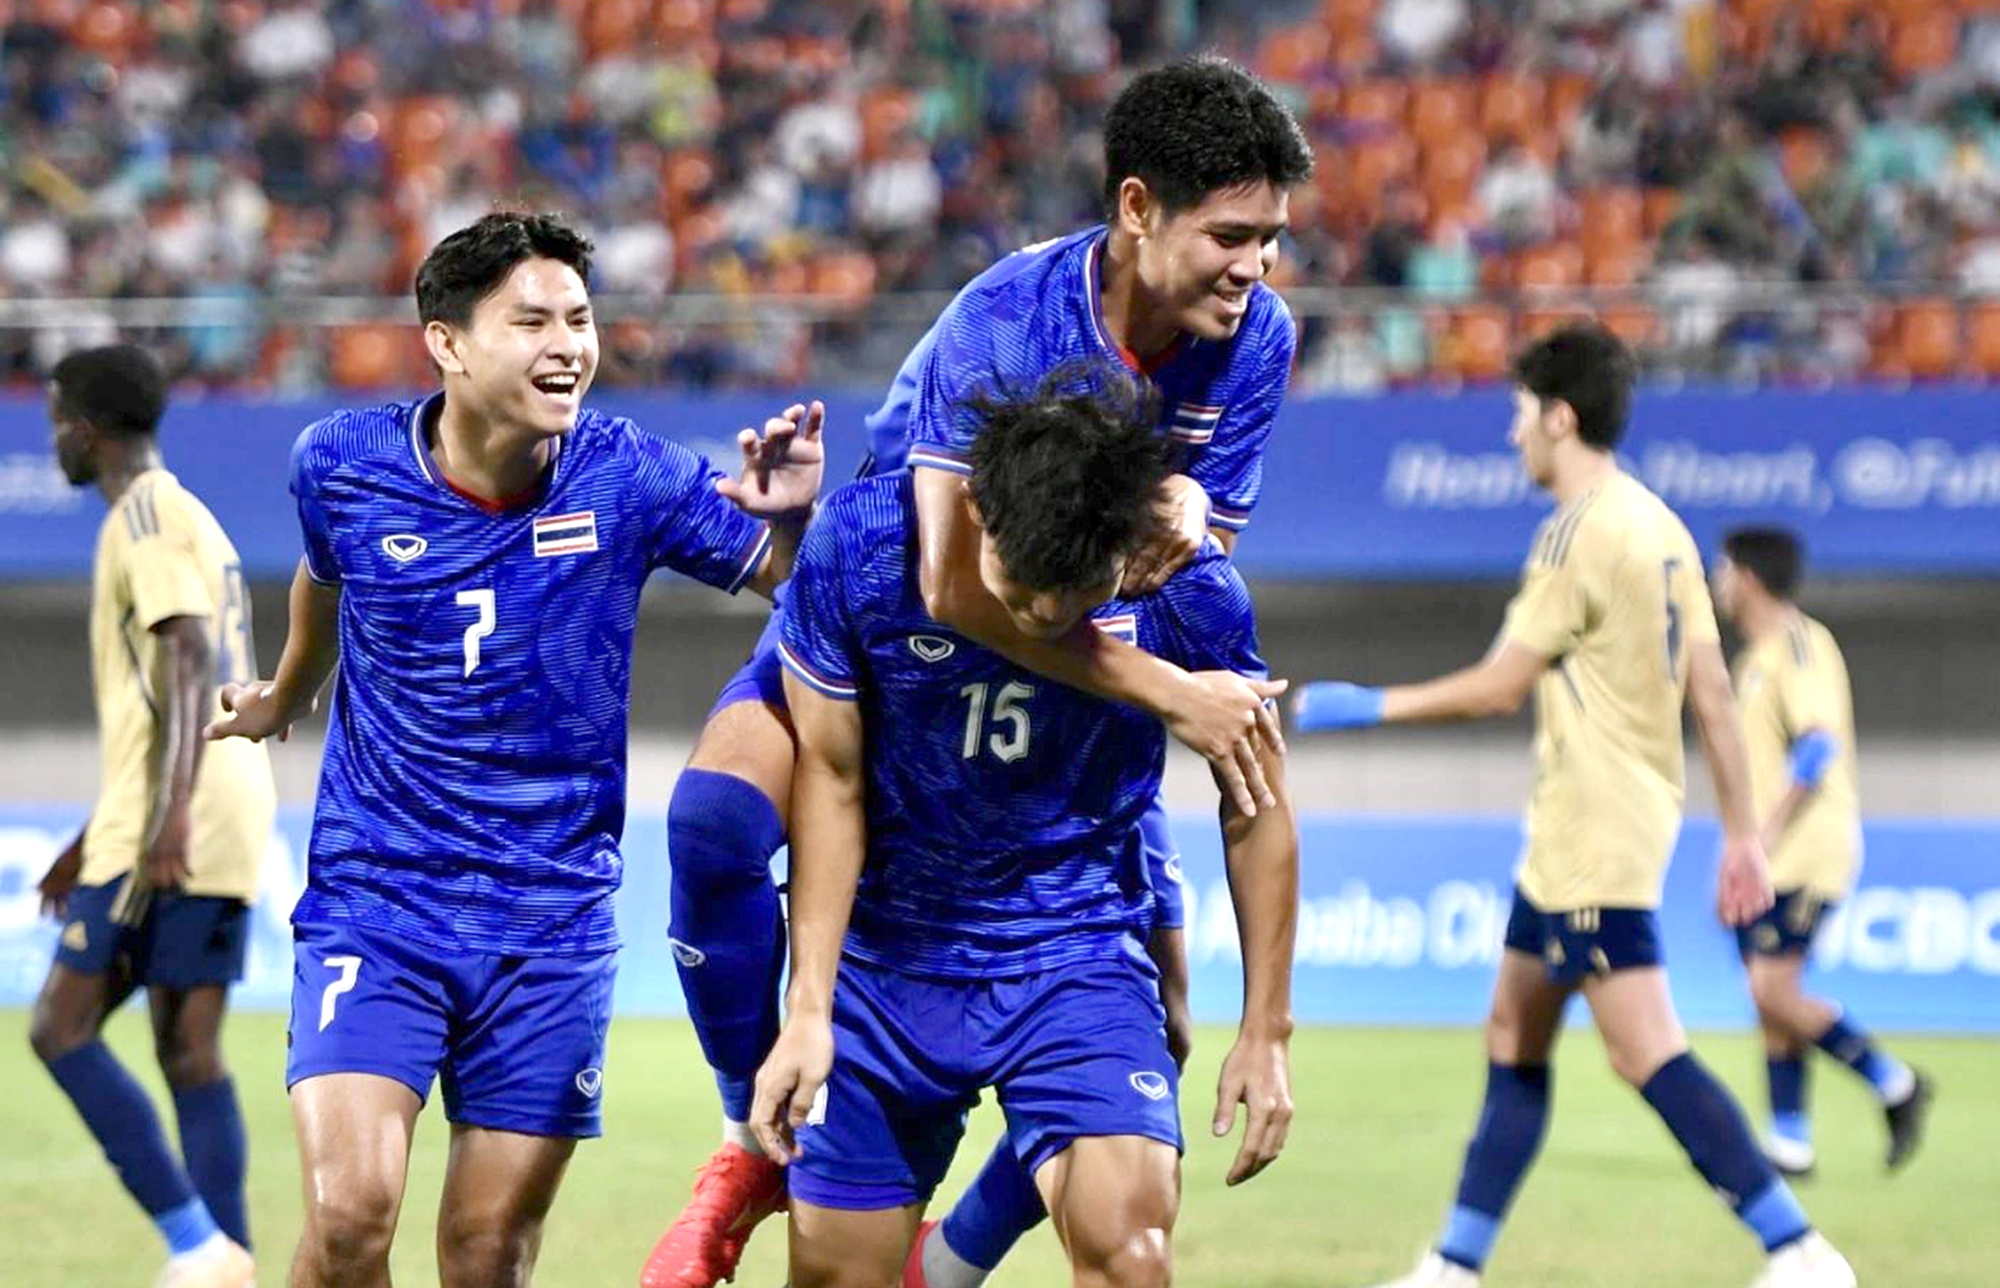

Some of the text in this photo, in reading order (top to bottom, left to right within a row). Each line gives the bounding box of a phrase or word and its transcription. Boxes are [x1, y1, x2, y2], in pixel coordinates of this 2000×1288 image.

[1386, 442, 1541, 508] Hear
[457, 588, 496, 678] 7
[959, 680, 1034, 763] 15
[318, 956, 363, 1032] 7
